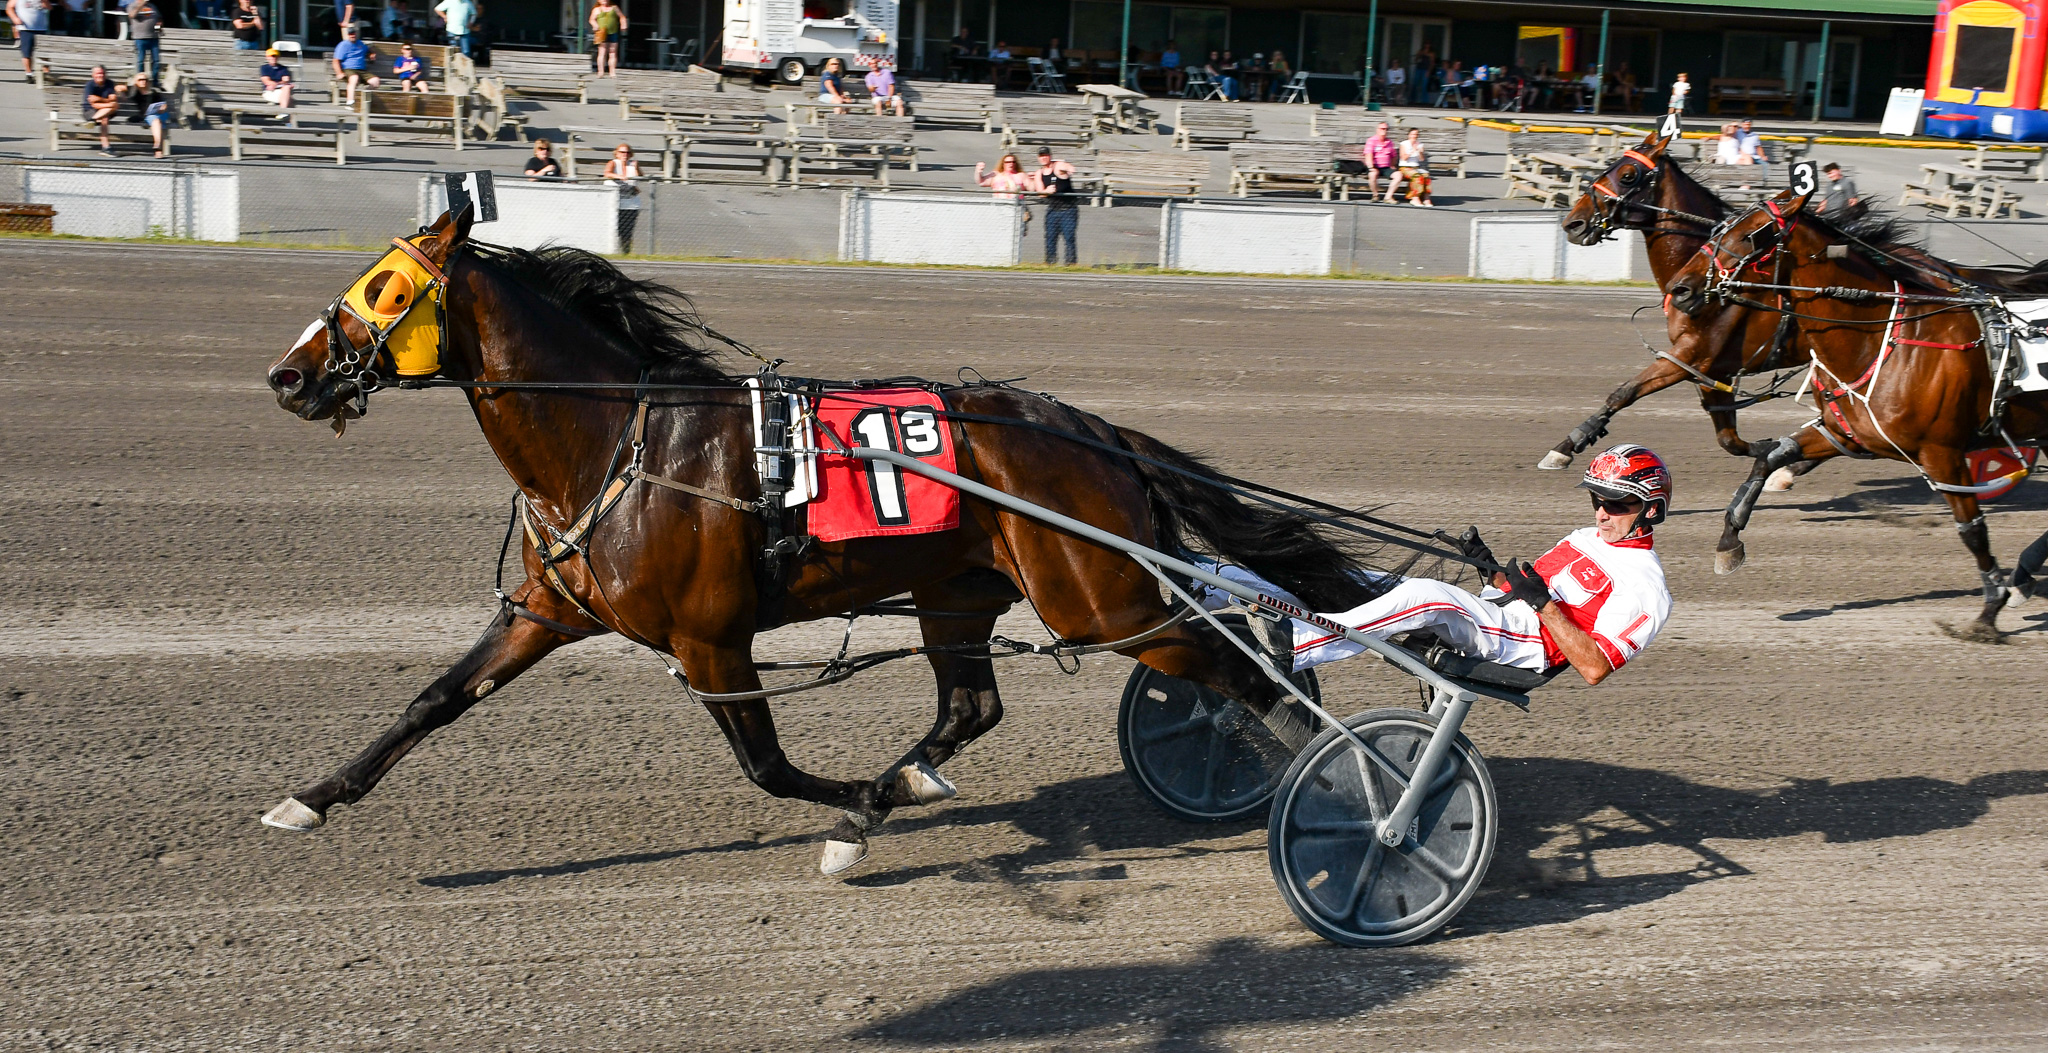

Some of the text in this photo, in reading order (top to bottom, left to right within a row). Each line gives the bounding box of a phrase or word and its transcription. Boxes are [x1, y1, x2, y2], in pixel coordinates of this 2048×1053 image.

[1660, 112, 1680, 141] 4
[461, 172, 483, 222] 1
[1793, 162, 1815, 196] 3
[1257, 593, 1347, 634] CHRIS LONG
[1615, 612, 1650, 652] L
